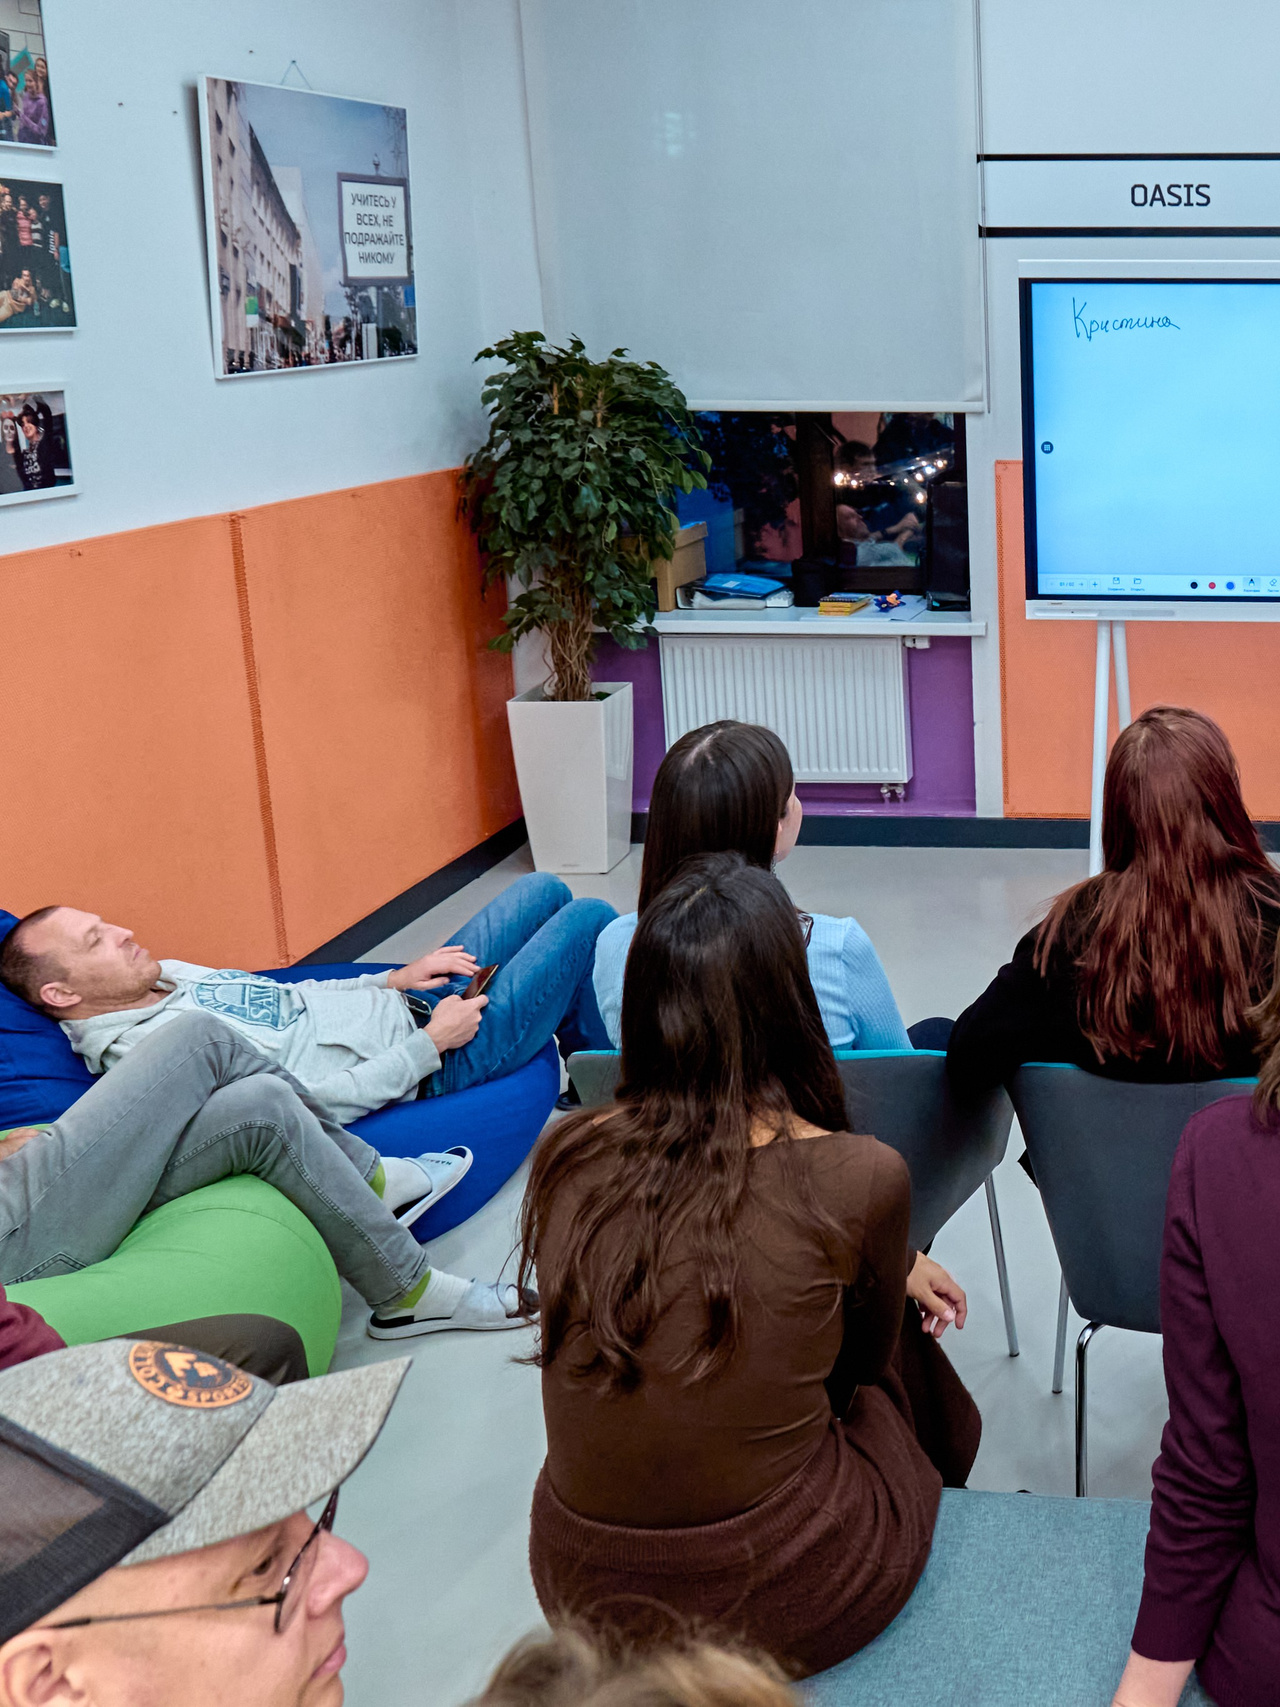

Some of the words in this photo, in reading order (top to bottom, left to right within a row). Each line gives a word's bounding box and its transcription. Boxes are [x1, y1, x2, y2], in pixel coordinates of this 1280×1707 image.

[351, 193, 390, 208] УЧИТЕСЬ
[391, 197, 397, 208] У
[1131, 184, 1211, 207] OASIS
[356, 213, 381, 228] ВСЕХ,
[383, 215, 394, 227] НЕ
[344, 231, 404, 247] ПОДРАЖАЙТЕ
[358, 252, 395, 264] НИКОМУ
[1072, 297, 1181, 342] Кристина
